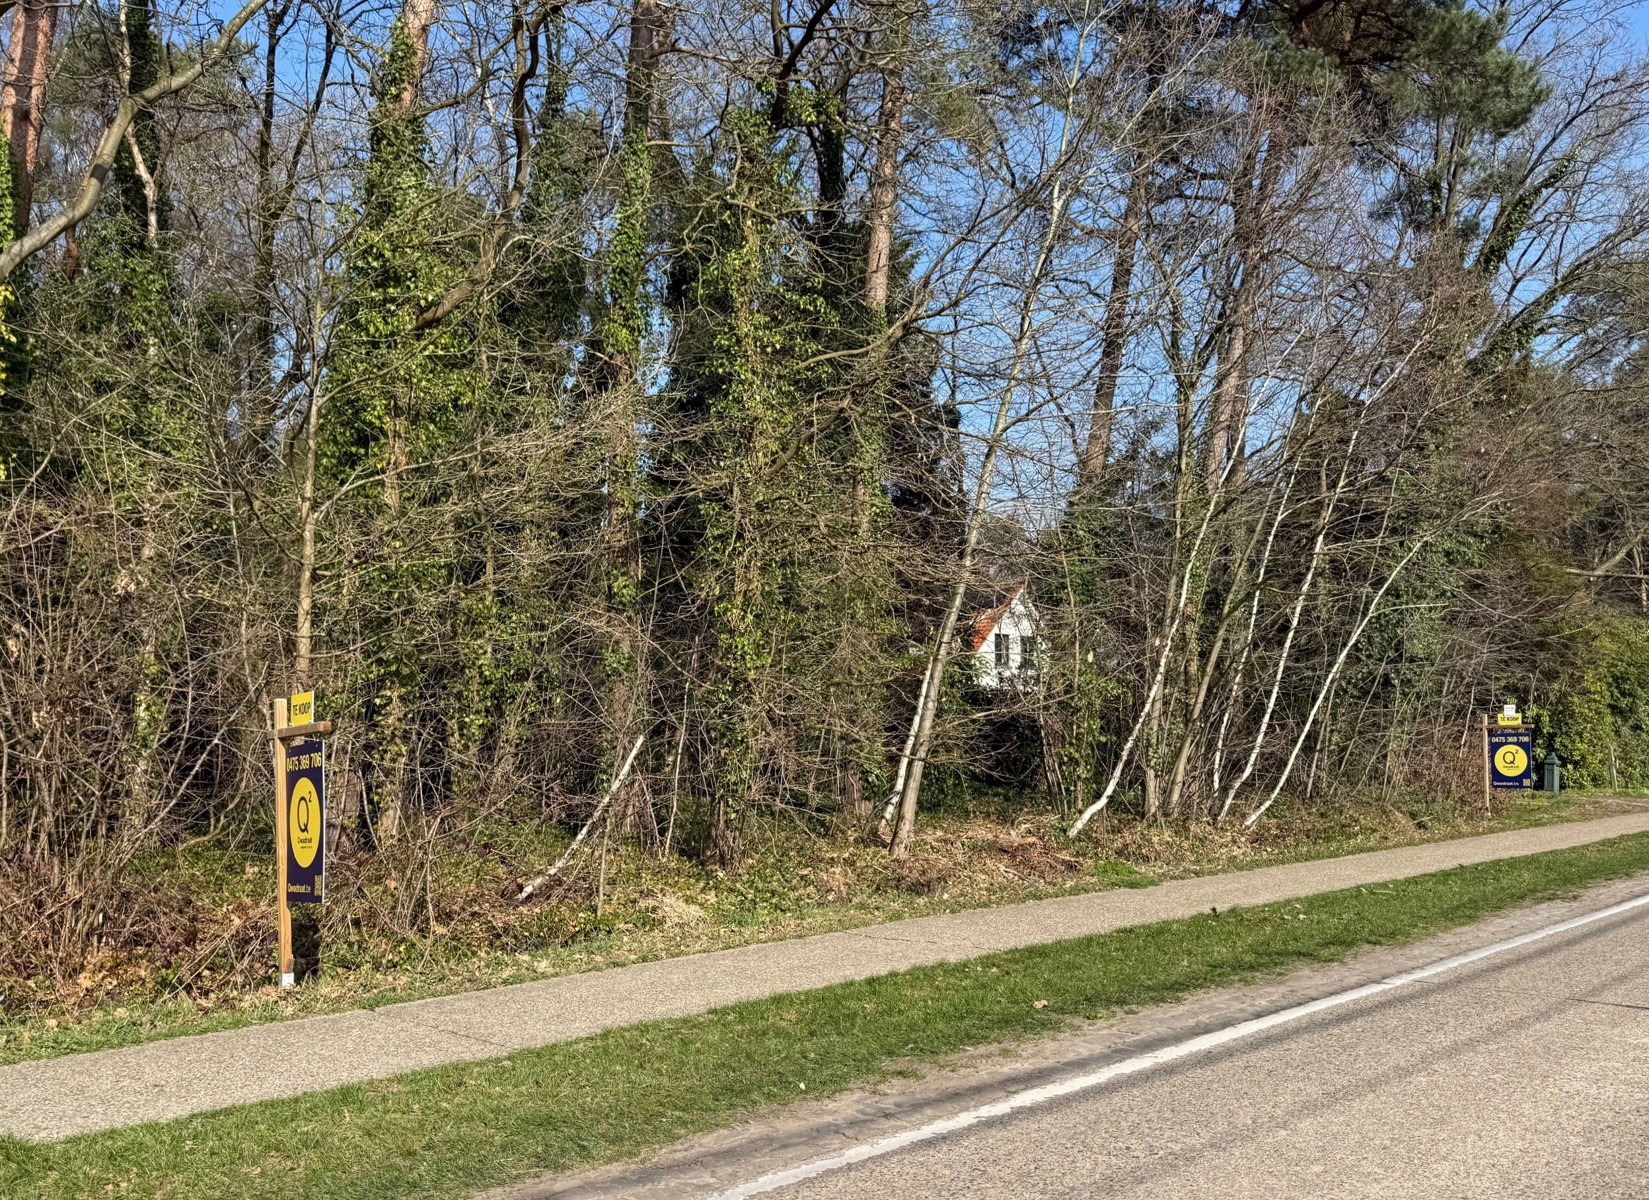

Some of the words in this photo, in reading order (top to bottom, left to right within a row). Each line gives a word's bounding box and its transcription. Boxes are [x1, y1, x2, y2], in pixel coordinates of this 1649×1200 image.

[293, 704, 298, 716] TE
[299, 702, 311, 715] KOOP
[286, 755, 299, 772] 0475
[310, 752, 322, 768] 706
